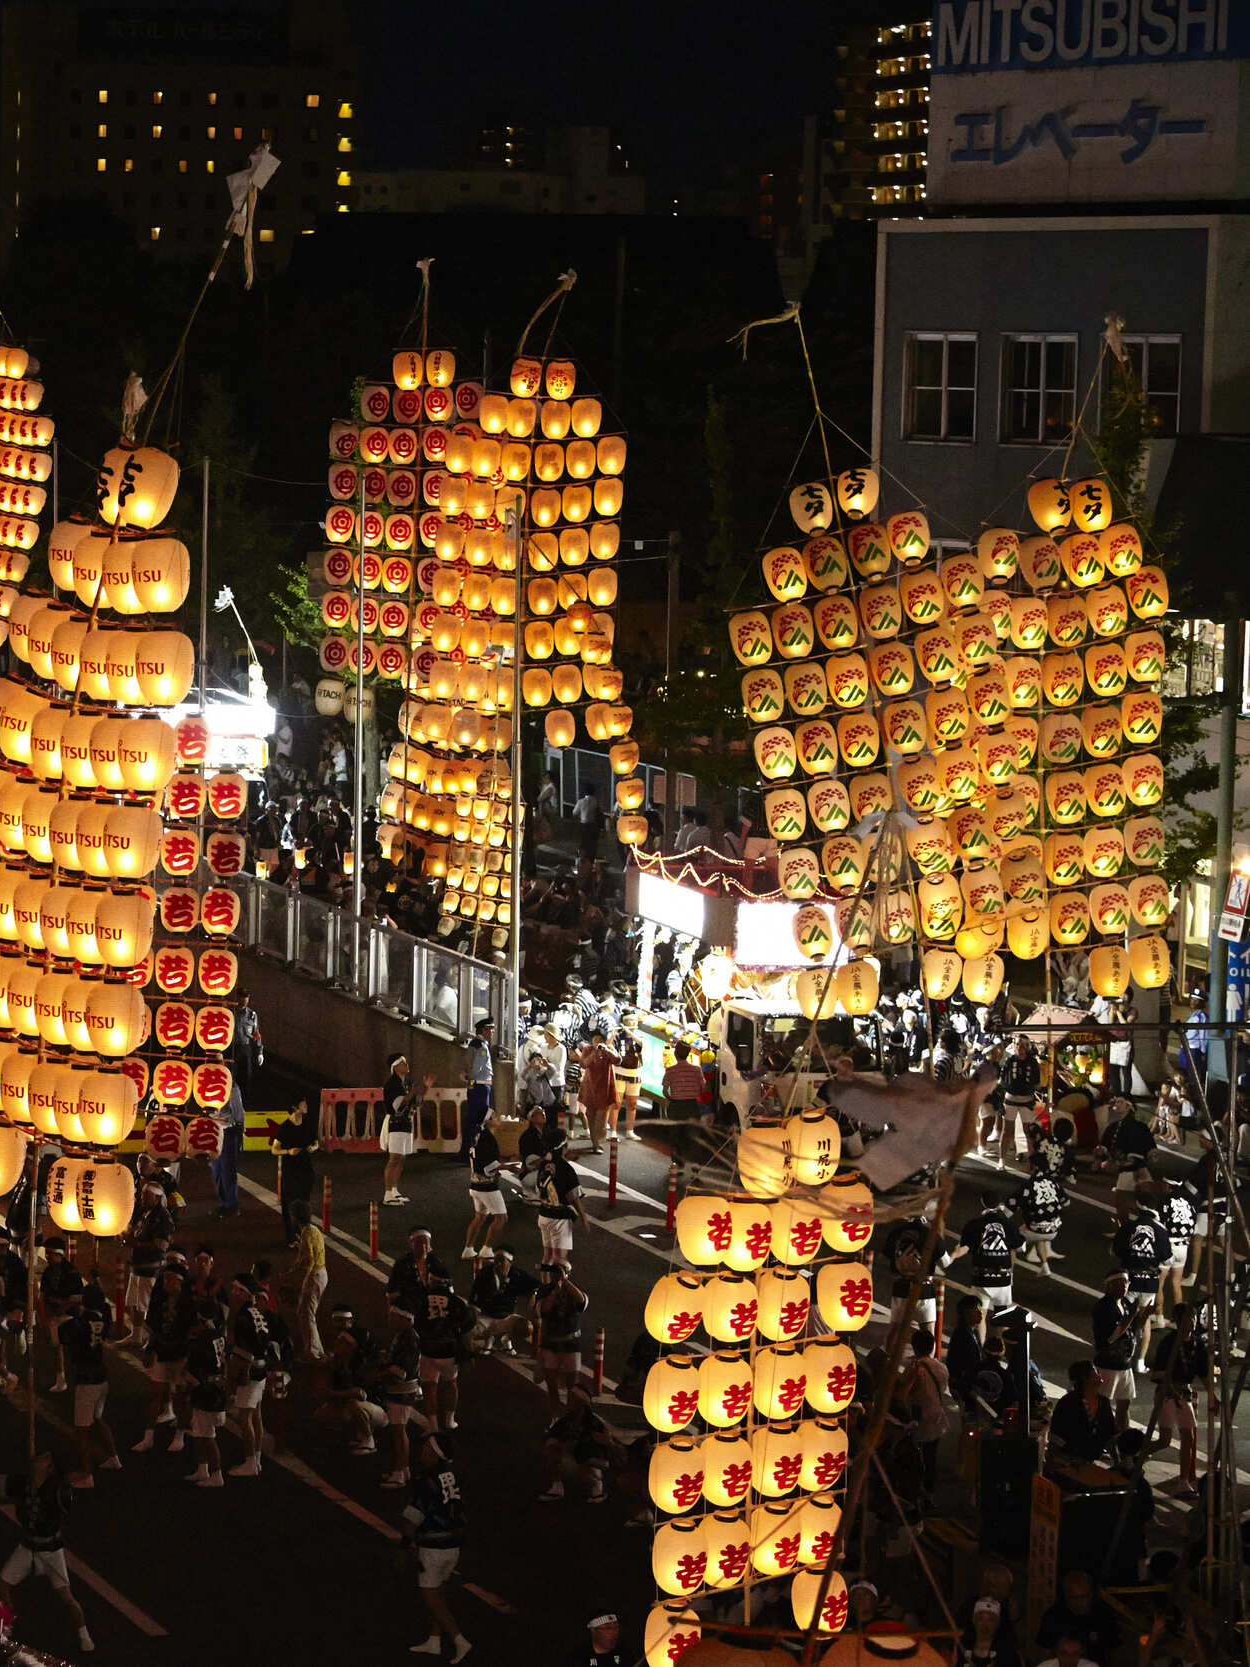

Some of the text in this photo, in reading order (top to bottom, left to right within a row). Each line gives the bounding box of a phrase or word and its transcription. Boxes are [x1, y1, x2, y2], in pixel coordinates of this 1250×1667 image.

[938, 0, 1228, 66] MITSUBISHI
[950, 99, 1205, 165] エレベーター
[1079, 485, 1102, 522] 七夕
[172, 781, 200, 815] 若
[212, 782, 241, 815] 若
[165, 837, 194, 871] 若
[211, 840, 240, 874] 若
[165, 893, 195, 927] 若
[204, 891, 234, 927] 若
[159, 955, 188, 989] 若
[202, 955, 231, 989] 若
[160, 1007, 190, 1042] 若
[200, 1011, 230, 1045] 若
[159, 1065, 188, 1100] 若
[198, 1068, 227, 1102] 若
[150, 1118, 179, 1154] 若
[187, 1117, 218, 1152] 若
[817, 1138, 831, 1179] 川尻小
[53, 1166, 67, 1204] 富士通
[791, 1218, 822, 1256] 若
[780, 1298, 810, 1334] 若
[840, 1278, 871, 1318] 若
[723, 1381, 752, 1418] 若
[779, 1375, 806, 1411] 若
[827, 1363, 856, 1402] 若
[669, 1389, 699, 1424] 若
[723, 1460, 752, 1497] 若
[774, 1453, 802, 1490] 若
[814, 1451, 846, 1485] 若
[673, 1470, 705, 1507] 若
[676, 1551, 707, 1589] 若
